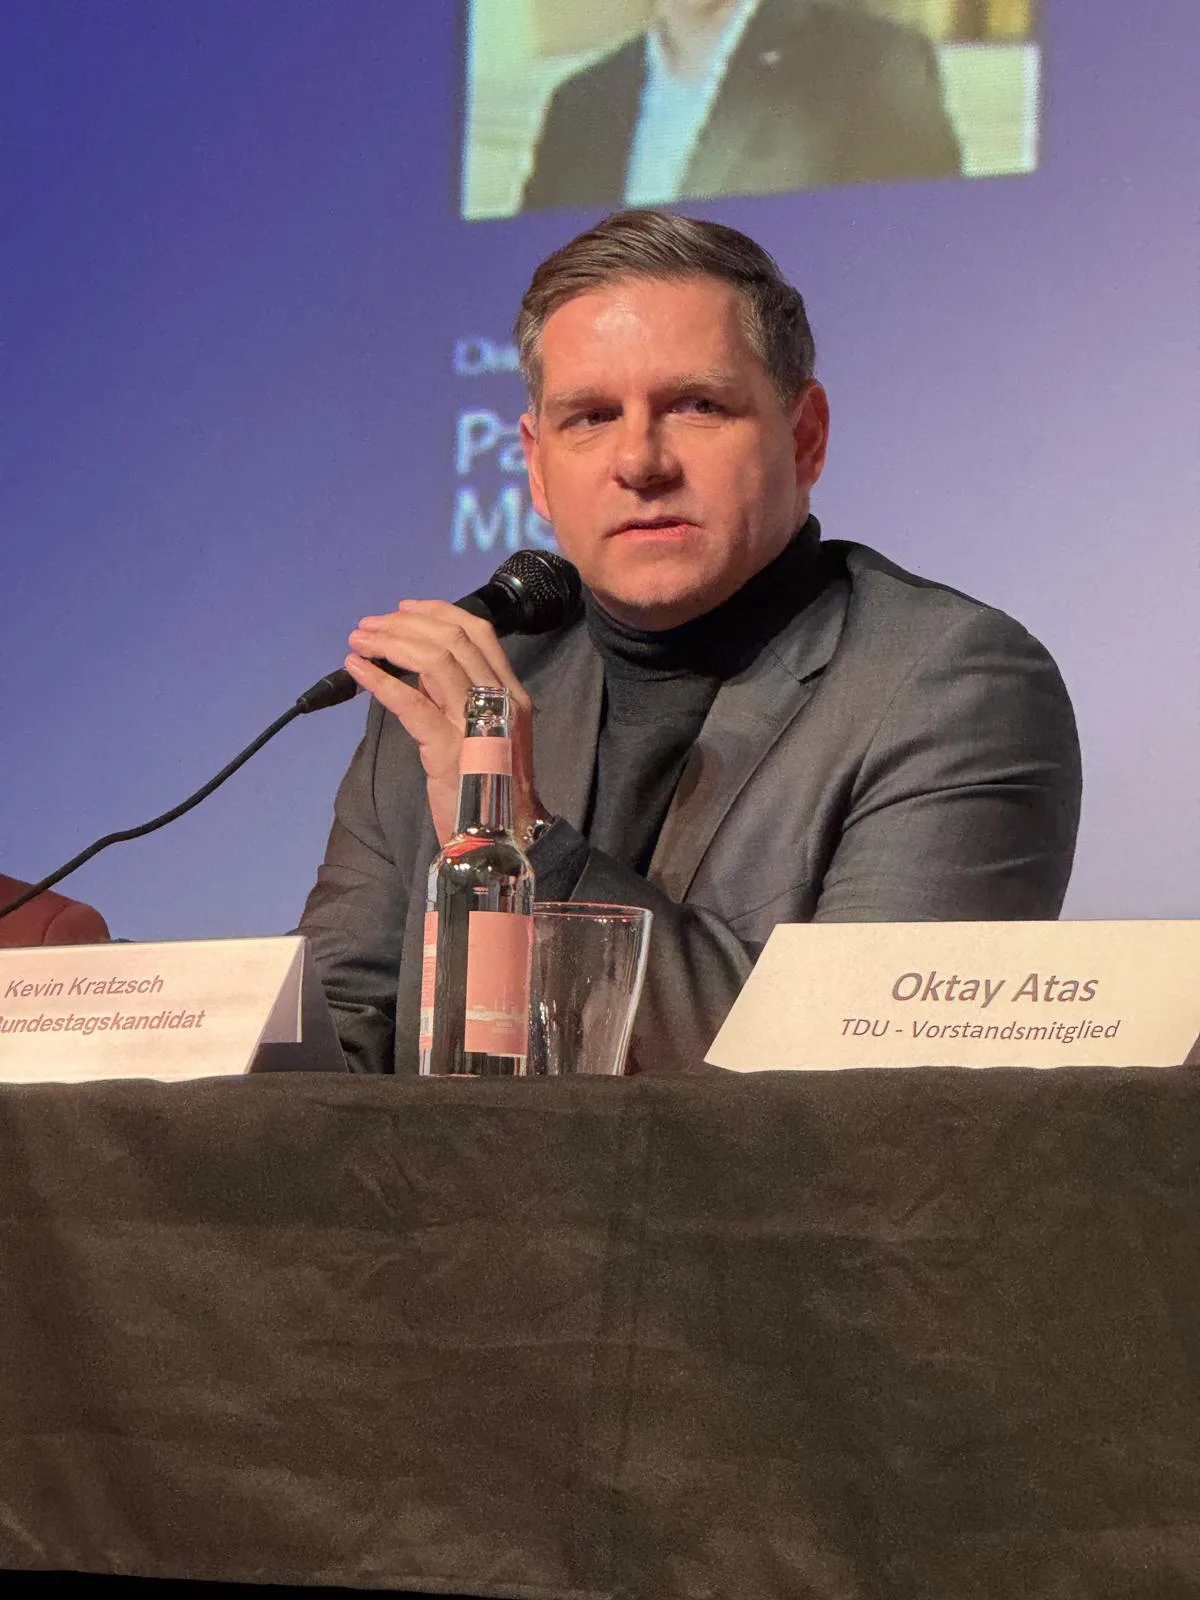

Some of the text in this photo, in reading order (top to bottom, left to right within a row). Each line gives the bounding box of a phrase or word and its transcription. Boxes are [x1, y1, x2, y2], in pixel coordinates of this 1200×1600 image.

[5, 975, 164, 998] Kevin Kratzsch
[891, 971, 1099, 1008] Oktay Atas
[841, 1018, 890, 1037] TDU
[911, 1019, 1121, 1044] Vorstandsmitglied
